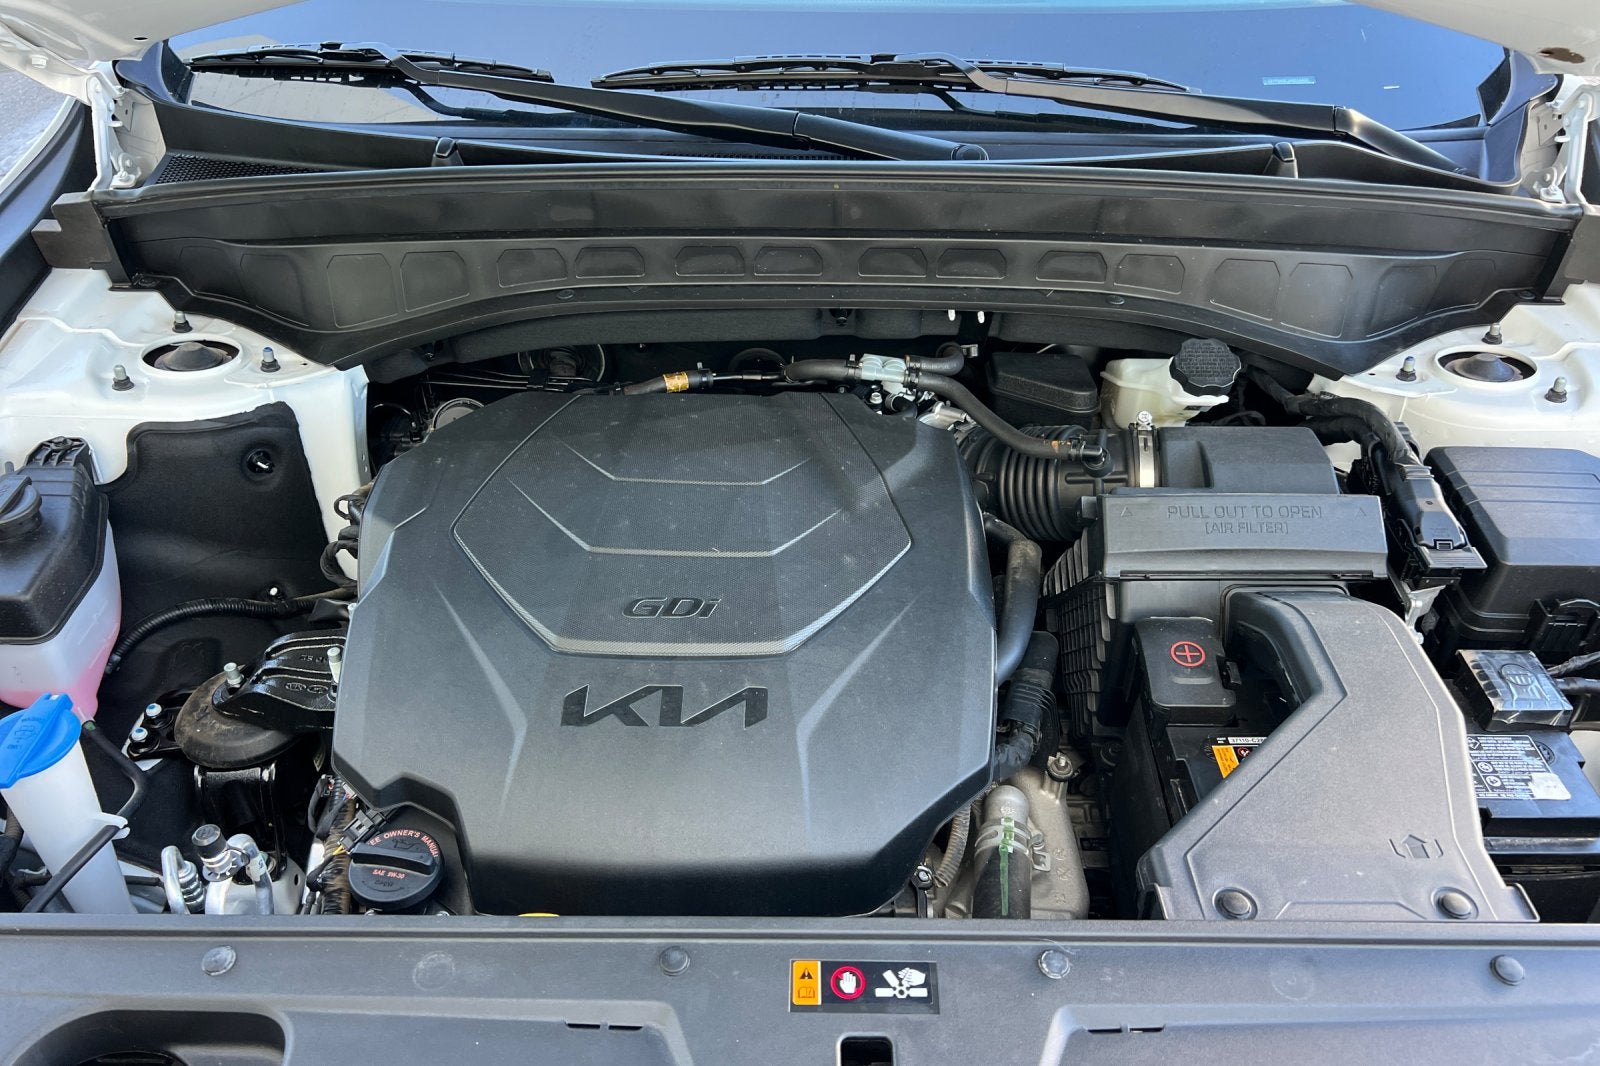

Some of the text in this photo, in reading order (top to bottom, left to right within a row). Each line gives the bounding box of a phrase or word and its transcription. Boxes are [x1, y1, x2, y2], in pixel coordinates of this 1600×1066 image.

[1167, 505, 1322, 519] PULL OUT TO OPEN
[622, 597, 722, 619] GDi
[384, 829, 421, 839] OWNER'S
